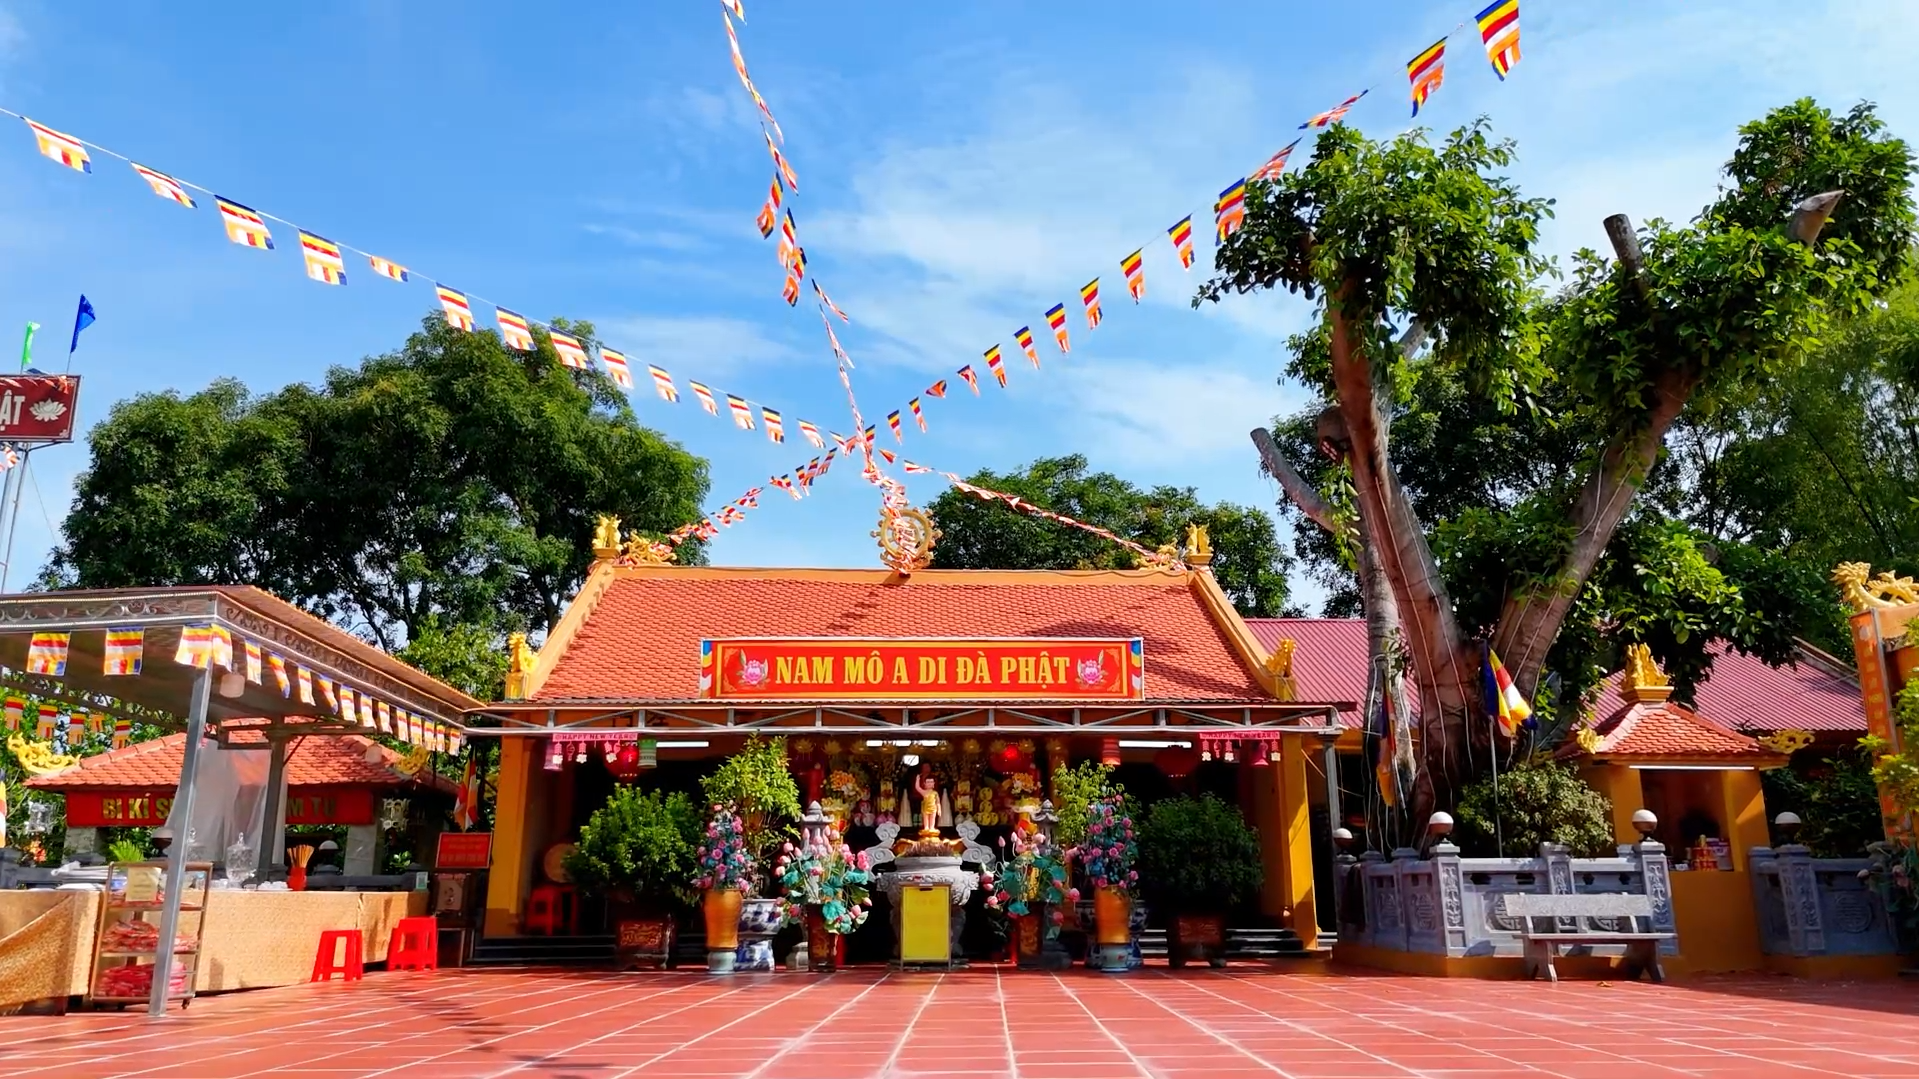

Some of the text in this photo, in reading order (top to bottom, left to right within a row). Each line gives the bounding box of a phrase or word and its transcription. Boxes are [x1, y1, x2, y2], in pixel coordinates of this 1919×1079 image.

[775, 650, 1070, 689] NAM MÔ A DI ĐÀ PHẬT
[128, 792, 151, 819] KÍ
